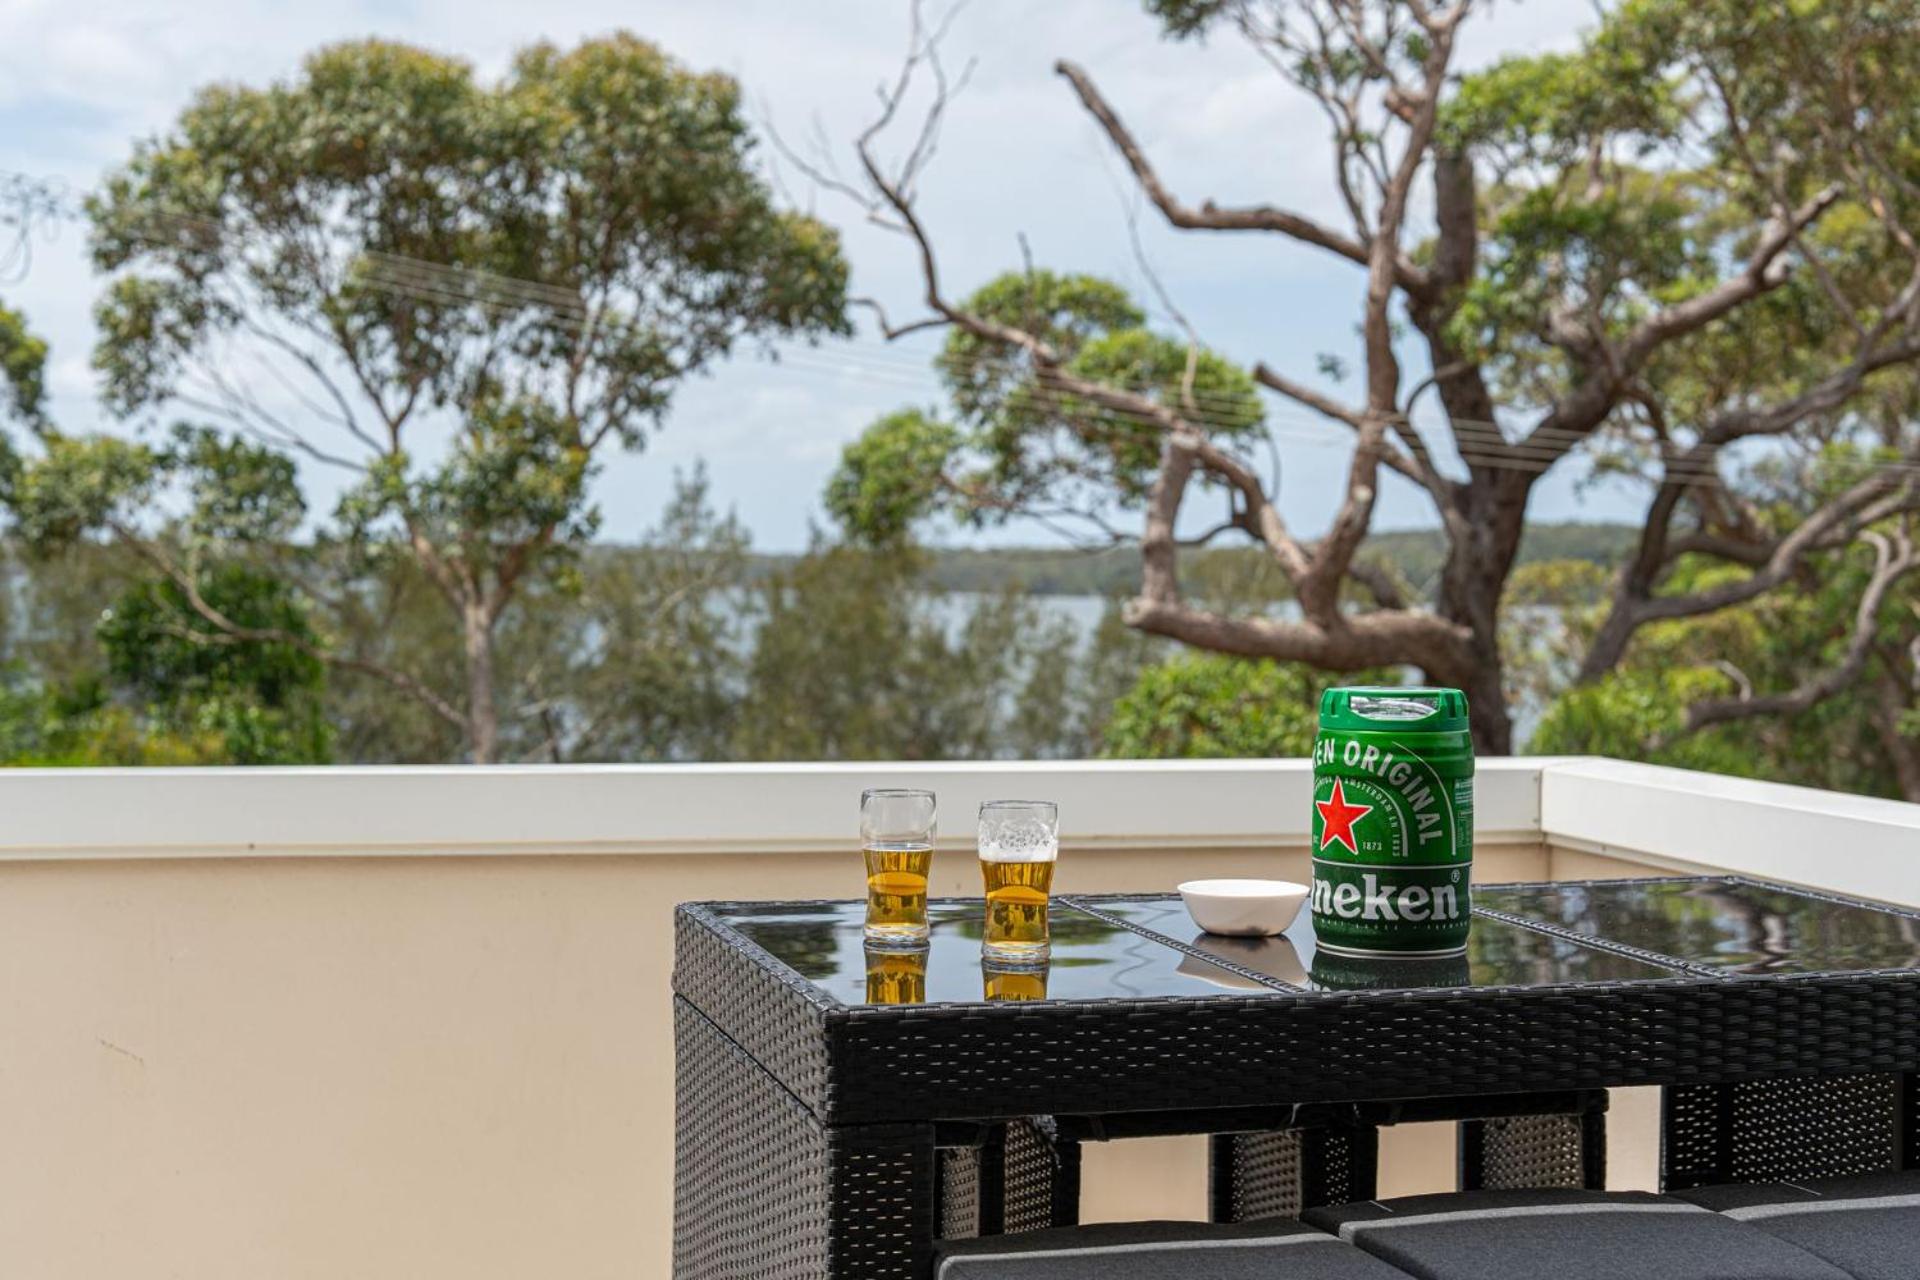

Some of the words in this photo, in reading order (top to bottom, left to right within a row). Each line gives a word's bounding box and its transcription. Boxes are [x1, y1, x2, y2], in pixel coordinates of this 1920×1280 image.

[1312, 738, 1335, 768] EN
[1343, 740, 1444, 846] ORIGINAL
[1362, 841, 1383, 851] 1873
[1311, 866, 1460, 922] neken
